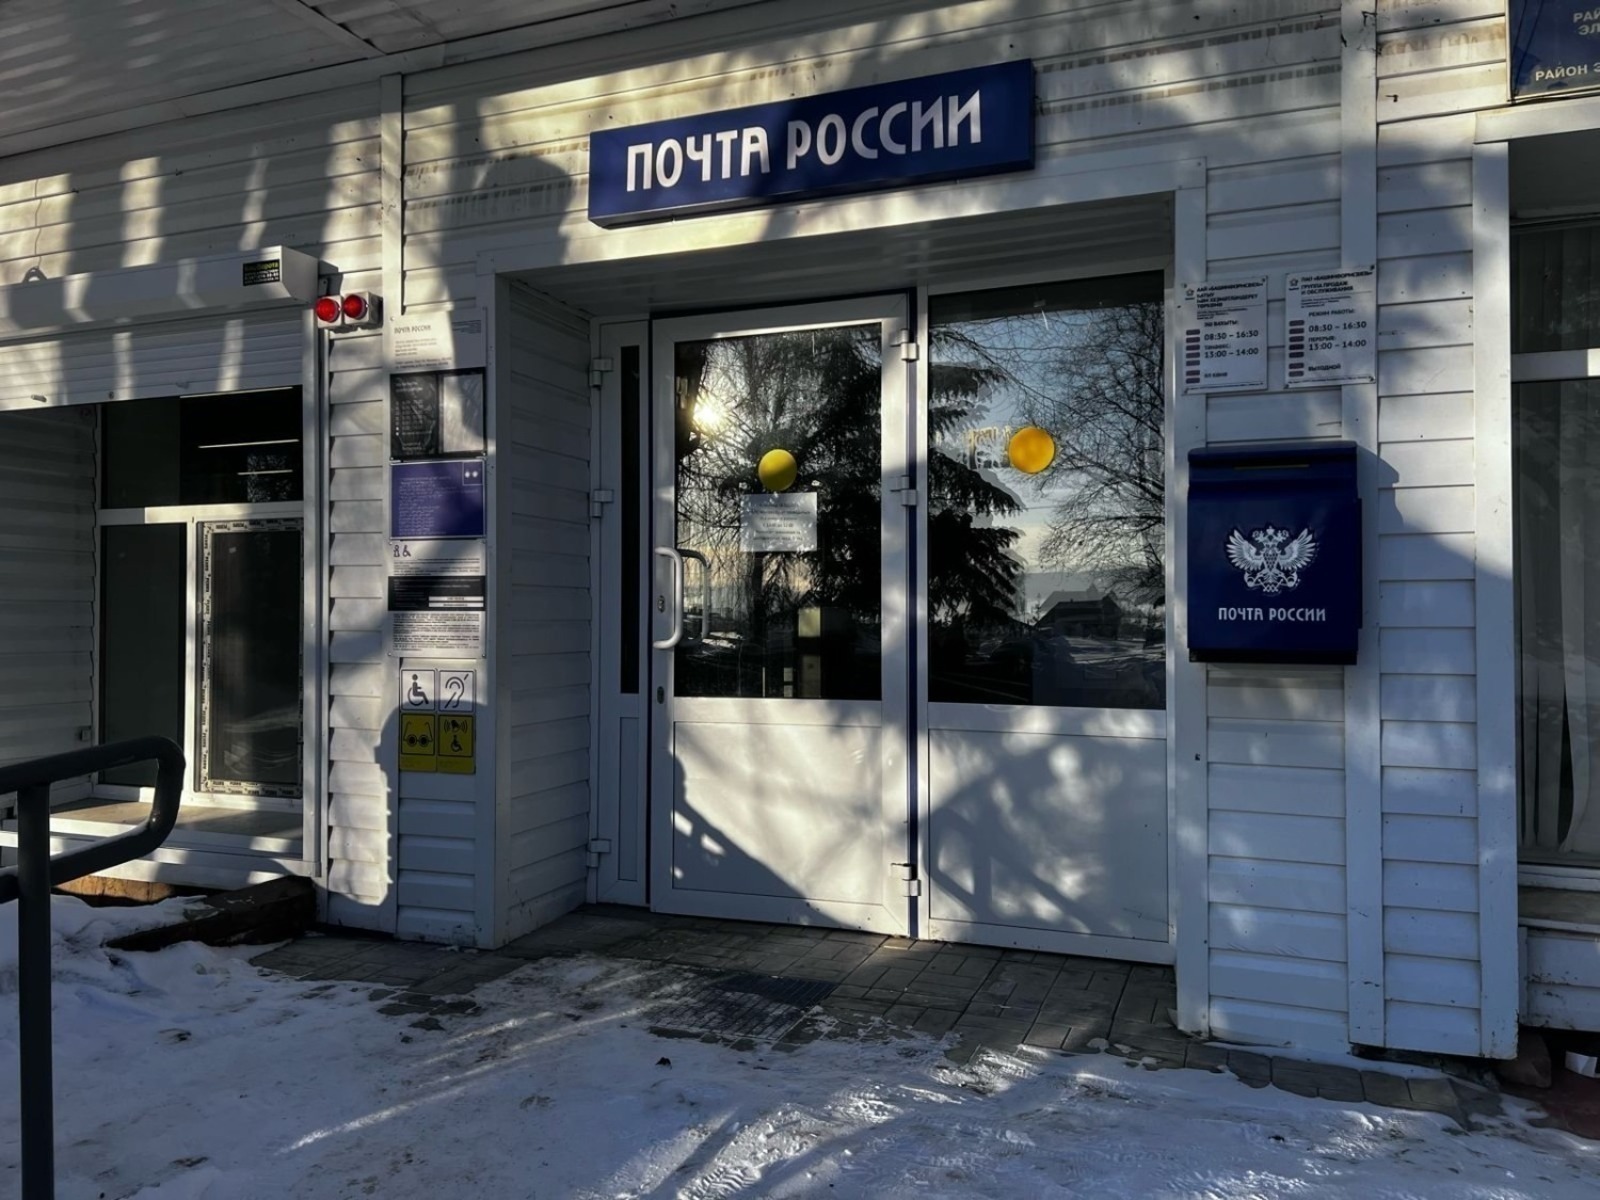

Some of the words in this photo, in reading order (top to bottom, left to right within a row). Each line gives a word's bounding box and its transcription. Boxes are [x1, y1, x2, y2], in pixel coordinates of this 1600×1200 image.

[1535, 64, 1588, 81] РАЙОН
[626, 126, 770, 192] ПОЧТА
[786, 89, 982, 171] РОССИИ
[1308, 324, 1333, 332] 08:30
[1343, 321, 1367, 330] 16:30
[1204, 332, 1227, 341] 08:30
[1236, 330, 1259, 338] 16:30
[1309, 342, 1333, 351] 13:00
[1342, 339, 1367, 348] 14:00
[1204, 350, 1227, 358] 13:00
[1236, 348, 1259, 356] 14:00
[1218, 607, 1264, 621] ПОЧТА
[1269, 607, 1326, 621] РОССИИ
